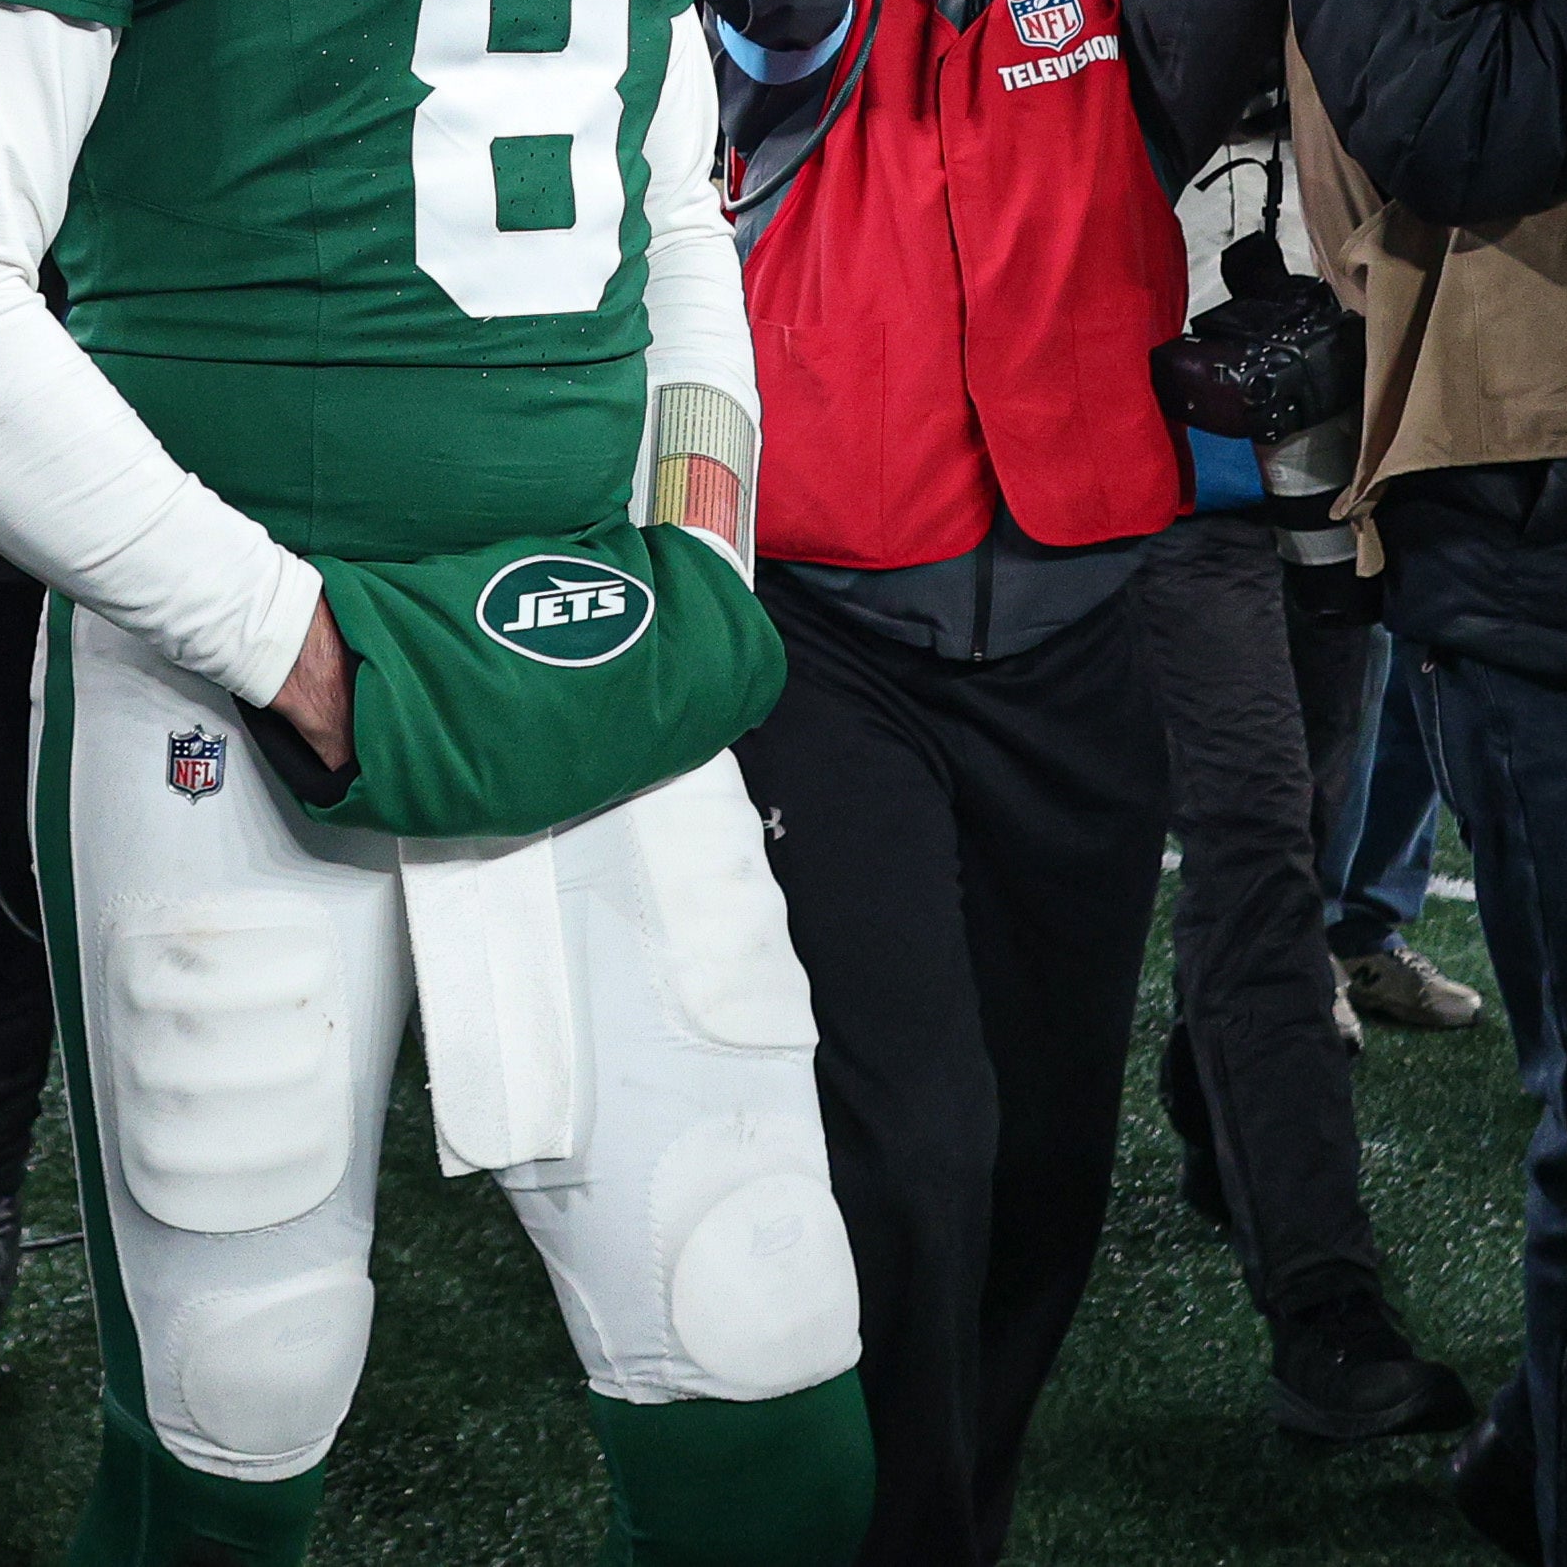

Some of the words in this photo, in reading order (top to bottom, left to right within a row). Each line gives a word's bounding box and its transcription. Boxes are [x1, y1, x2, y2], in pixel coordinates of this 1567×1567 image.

[1022, 7, 1077, 40] NFL
[998, 35, 1119, 91] TELEVISION
[503, 575, 626, 633] JETS
[175, 759, 215, 791] NFL
